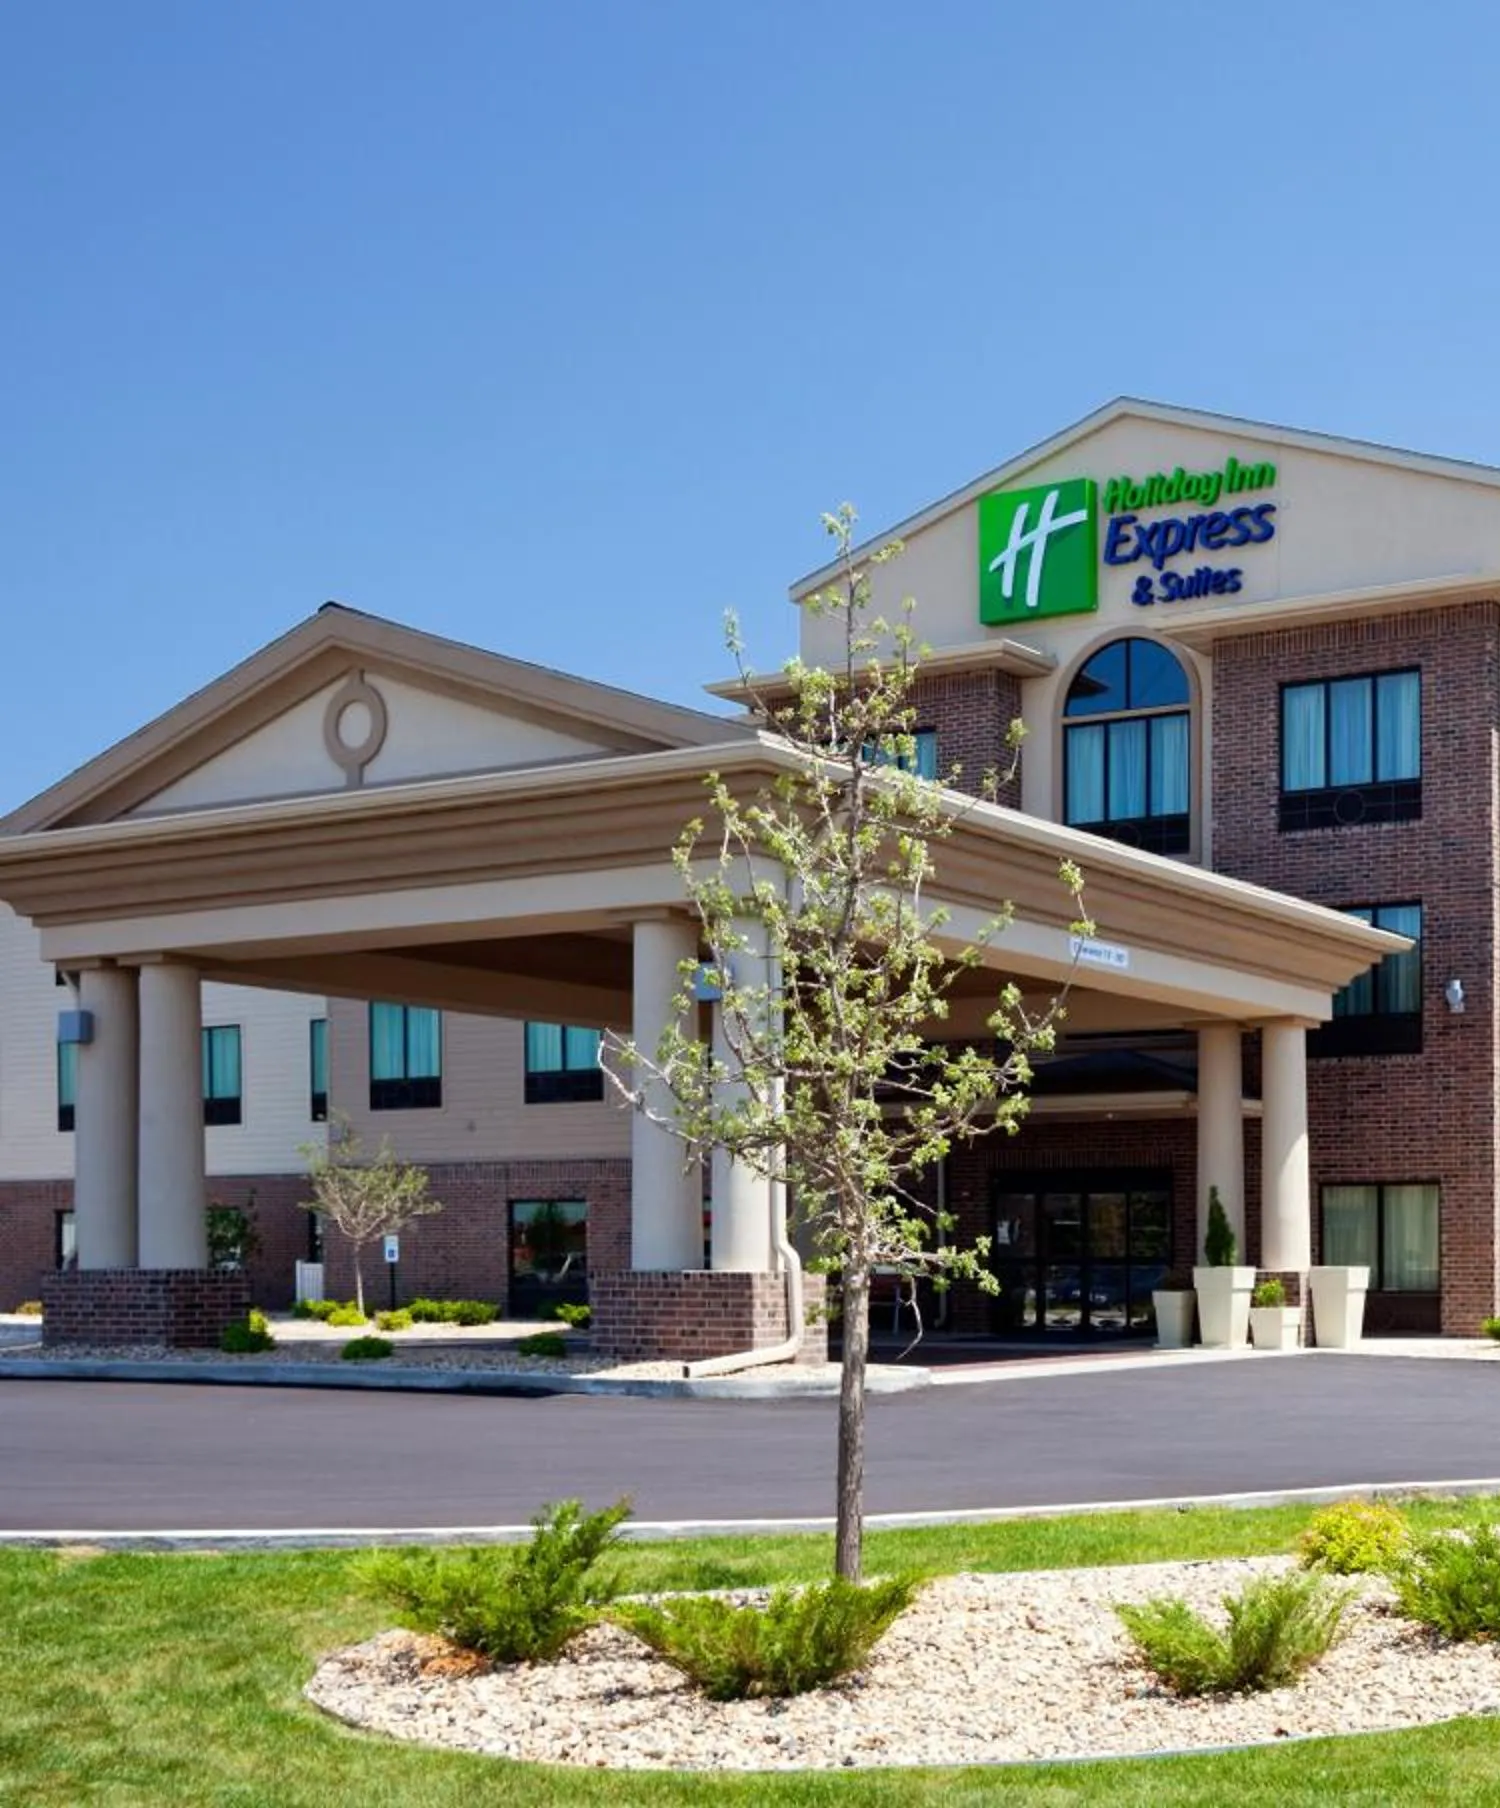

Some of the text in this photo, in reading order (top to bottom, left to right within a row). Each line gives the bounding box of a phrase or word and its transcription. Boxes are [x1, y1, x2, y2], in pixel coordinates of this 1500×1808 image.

[989, 489, 1088, 608] H
[1103, 503, 1276, 570] Express
[1131, 567, 1243, 606] & Suites
